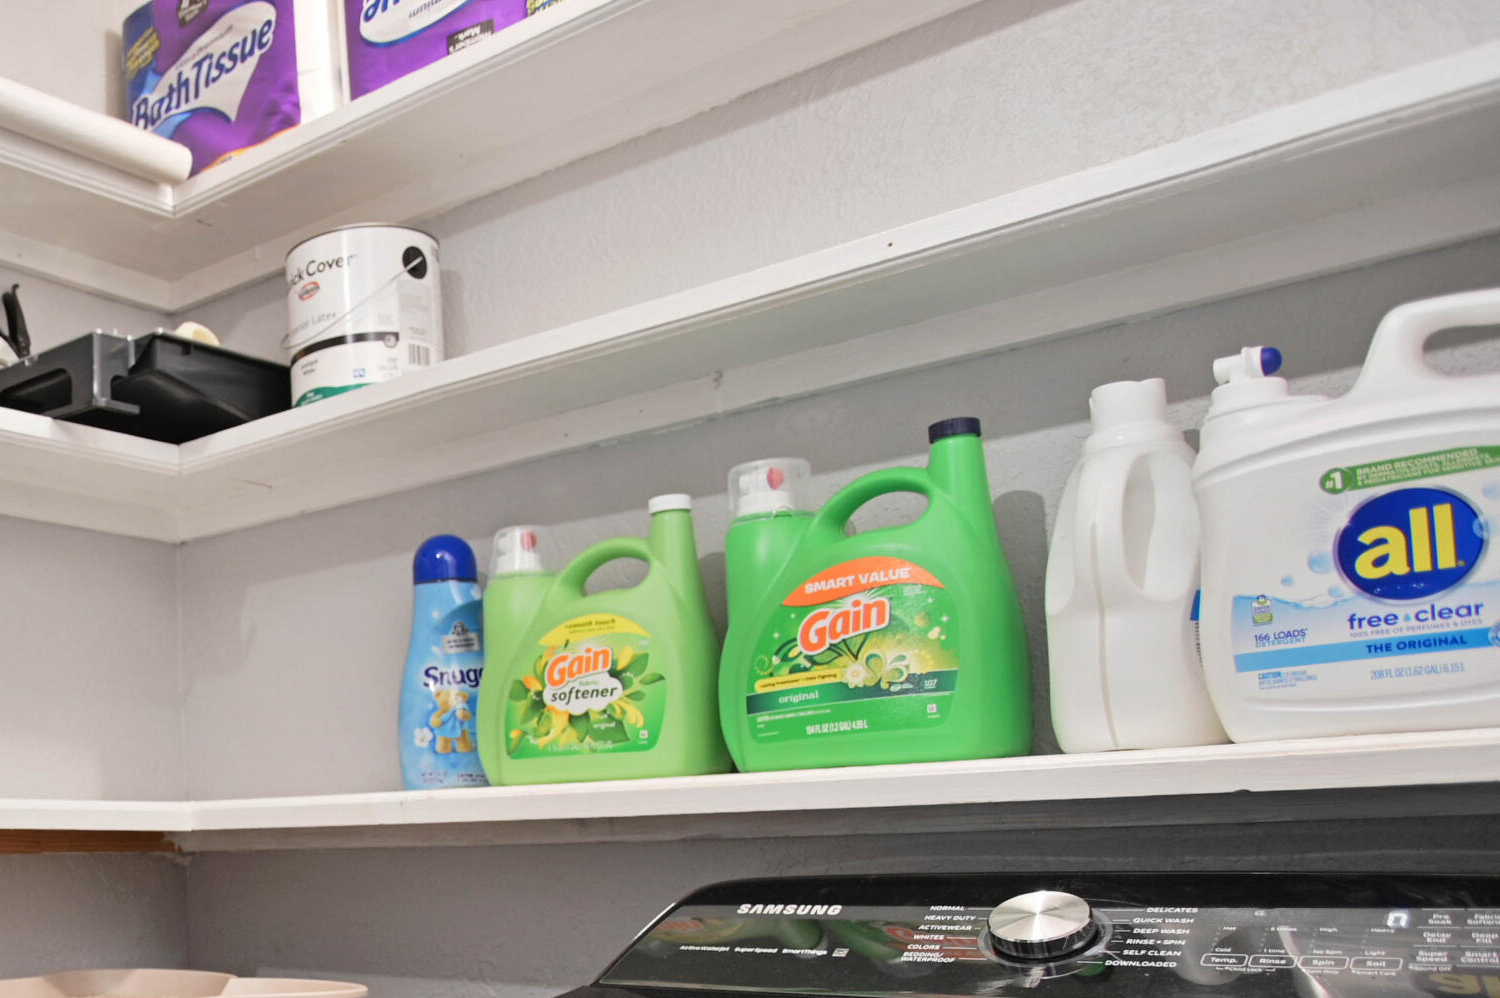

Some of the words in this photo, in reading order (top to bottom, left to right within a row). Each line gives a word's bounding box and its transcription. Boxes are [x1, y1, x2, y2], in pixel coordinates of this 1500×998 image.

[135, 71, 190, 130] Bath
[191, 19, 273, 99] Tissue
[306, 254, 354, 277] Cover
[1356, 462, 1393, 475] BRAND
[1393, 448, 1478, 469] RECOMMENDED
[1326, 471, 1343, 489] #1
[1355, 503, 1458, 580] all
[804, 576, 855, 594] SMART
[858, 567, 911, 584] VALUE
[799, 599, 889, 654] Gain
[1348, 611, 1399, 631] free
[1414, 603, 1484, 623] clear
[1254, 633, 1270, 642] 166
[1371, 628, 1390, 636] FREE
[1406, 622, 1451, 633] PERFUMES
[1255, 636, 1306, 647] DETERGENT
[1366, 643, 1393, 654] THE
[1402, 635, 1468, 652] ORIGINAL
[547, 647, 612, 687] Gain
[551, 686, 617, 705] softener
[778, 690, 820, 704] original
[593, 721, 616, 730] original
[737, 904, 842, 915] SAMSUNG
[782, 948, 828, 956] SmartThings
[1105, 960, 1177, 968] DOWNLOADED
